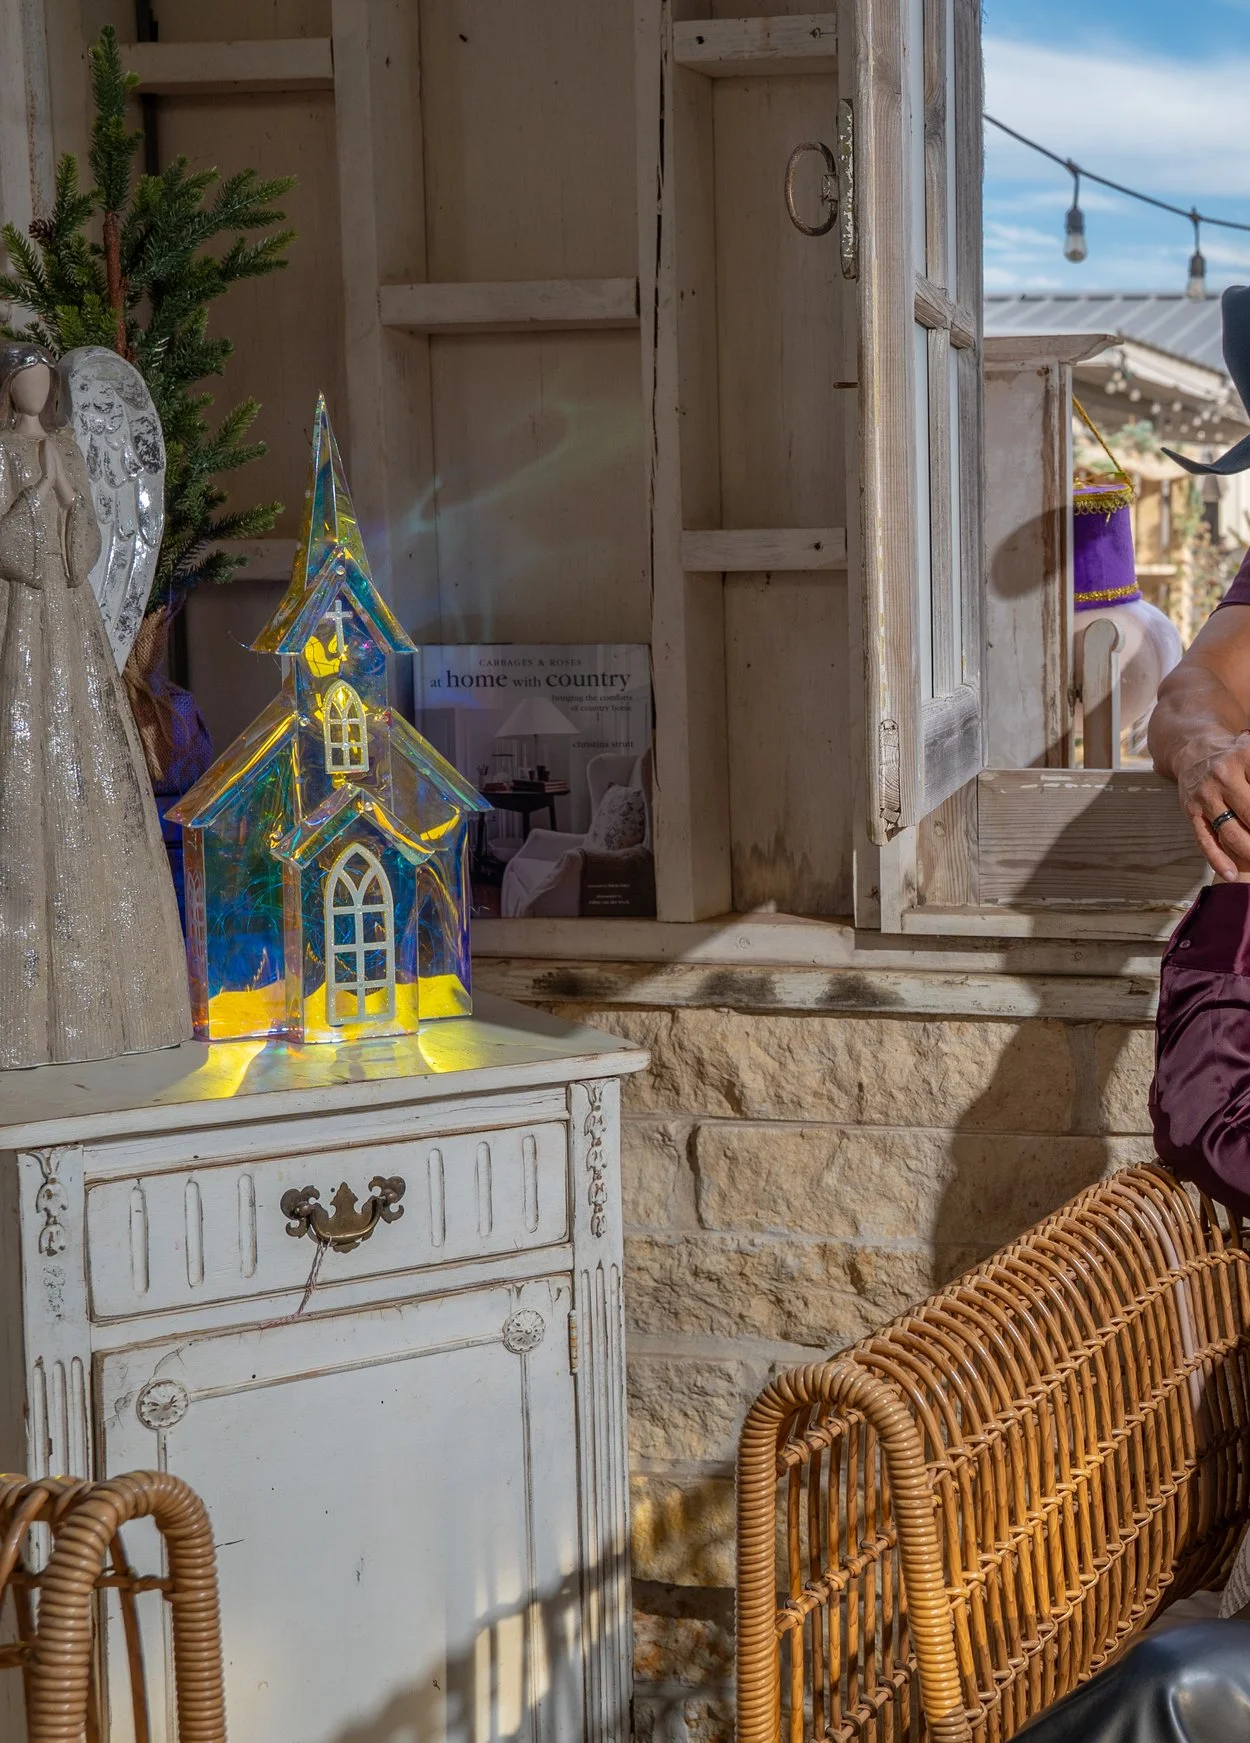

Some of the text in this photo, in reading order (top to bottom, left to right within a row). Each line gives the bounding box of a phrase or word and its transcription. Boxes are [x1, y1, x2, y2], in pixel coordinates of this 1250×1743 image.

[478, 658, 582, 667] CABBAGES & ROSES
[430, 669, 632, 692] at home with country
